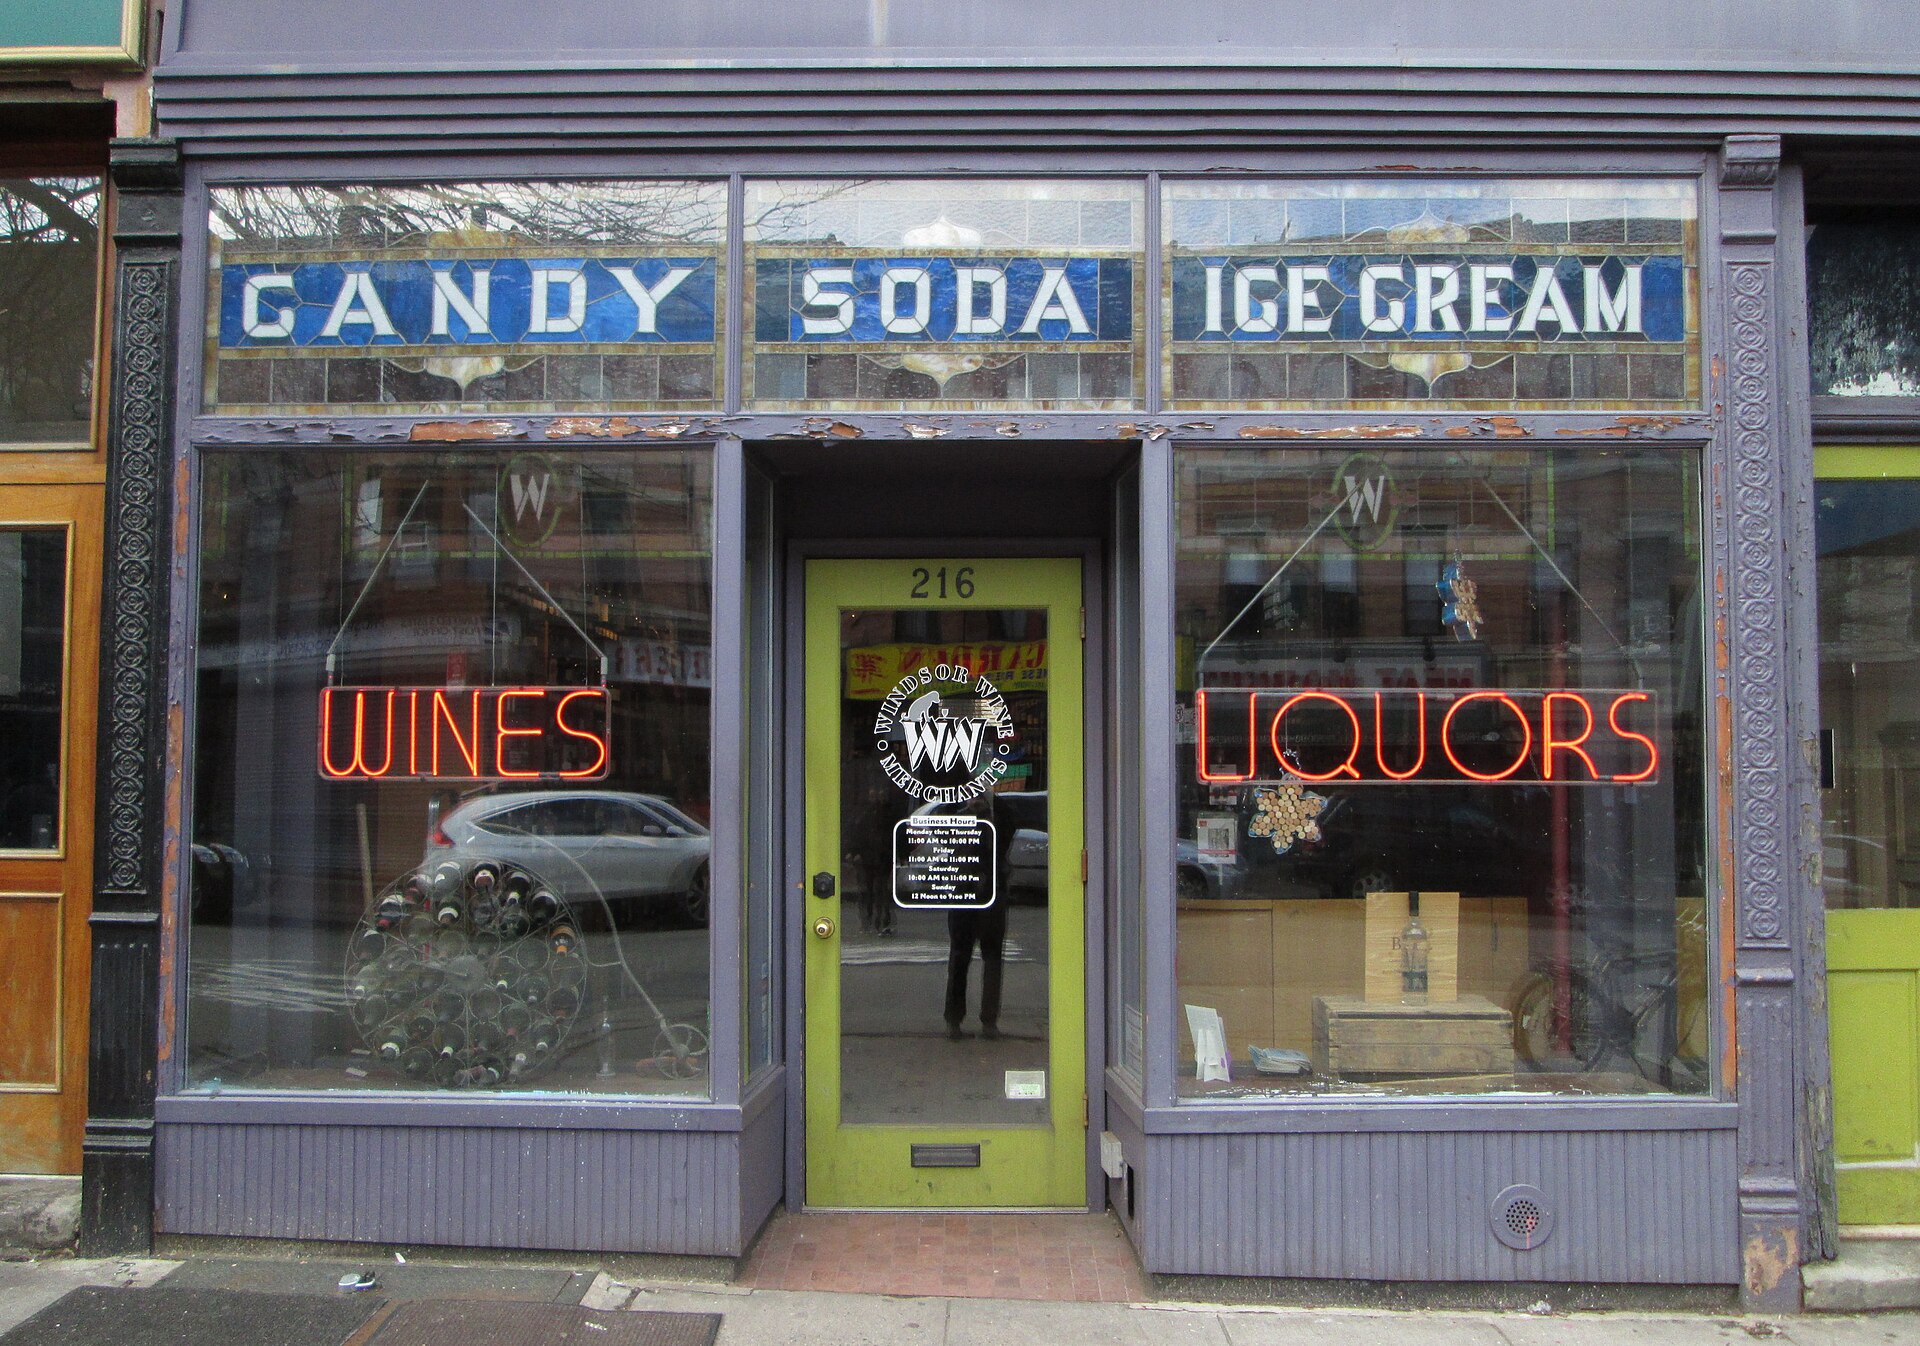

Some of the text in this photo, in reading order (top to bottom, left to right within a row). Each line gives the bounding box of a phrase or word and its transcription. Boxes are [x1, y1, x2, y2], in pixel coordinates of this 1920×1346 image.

[802, 267, 1090, 334] SODA
[910, 566, 976, 599] 216
[873, 663, 1015, 739] WINDSOR WINE
[322, 688, 606, 777] WINES
[1198, 690, 1659, 782] LIQUORS
[879, 752, 1008, 804] MERCHANTS
[906, 828, 933, 836] Monday
[950, 828, 982, 836] Thursday
[912, 817, 976, 825] Business Hours
[931, 884, 956, 892] Sunday
